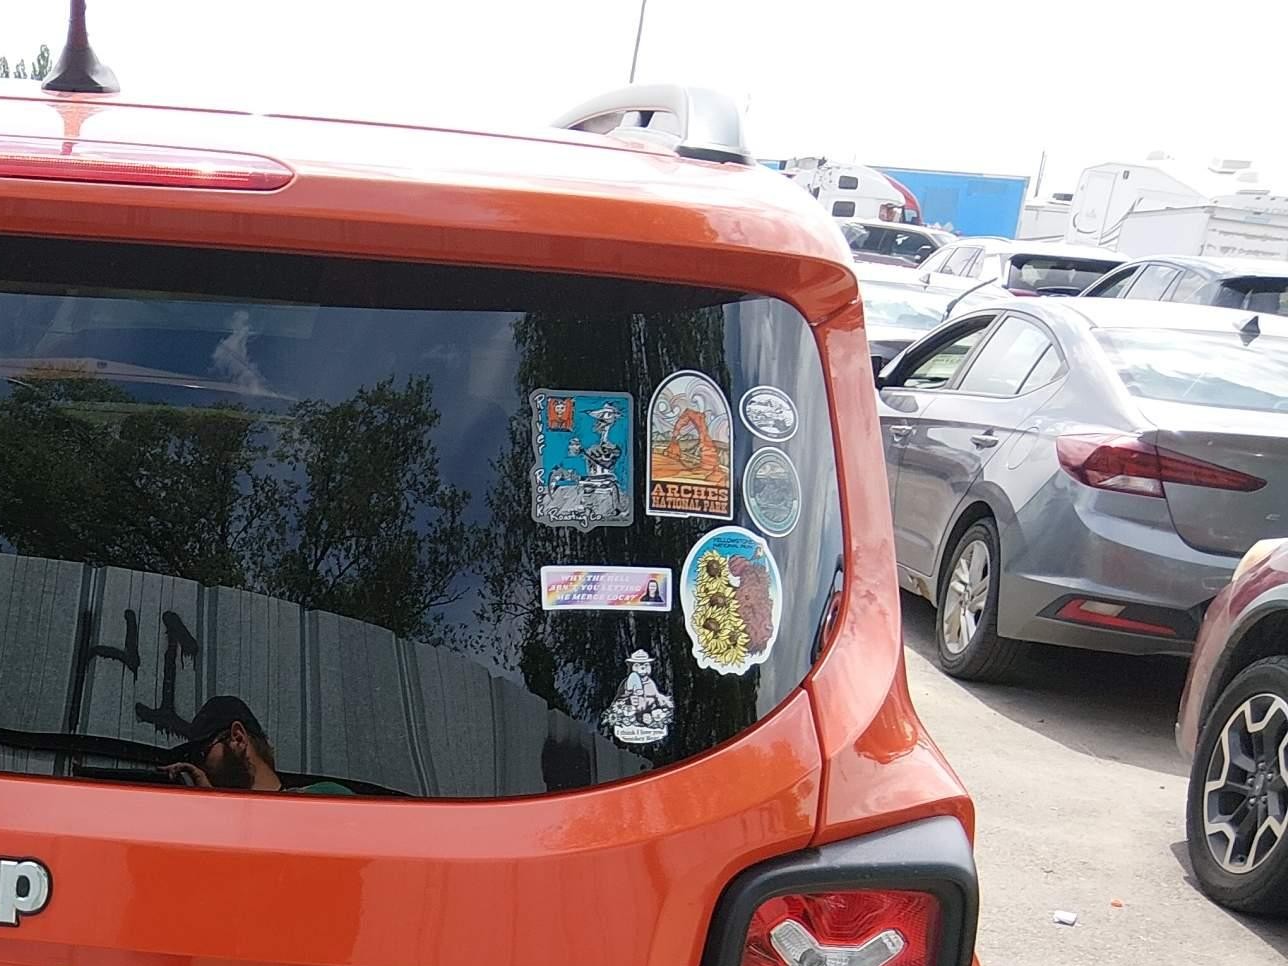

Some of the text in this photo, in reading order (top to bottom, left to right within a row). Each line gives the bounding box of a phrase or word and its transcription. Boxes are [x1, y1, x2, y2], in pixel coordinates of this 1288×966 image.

[533, 394, 546, 455] River
[651, 483, 729, 502] ARCHES
[651, 495, 728, 514] NATIONAL PARK
